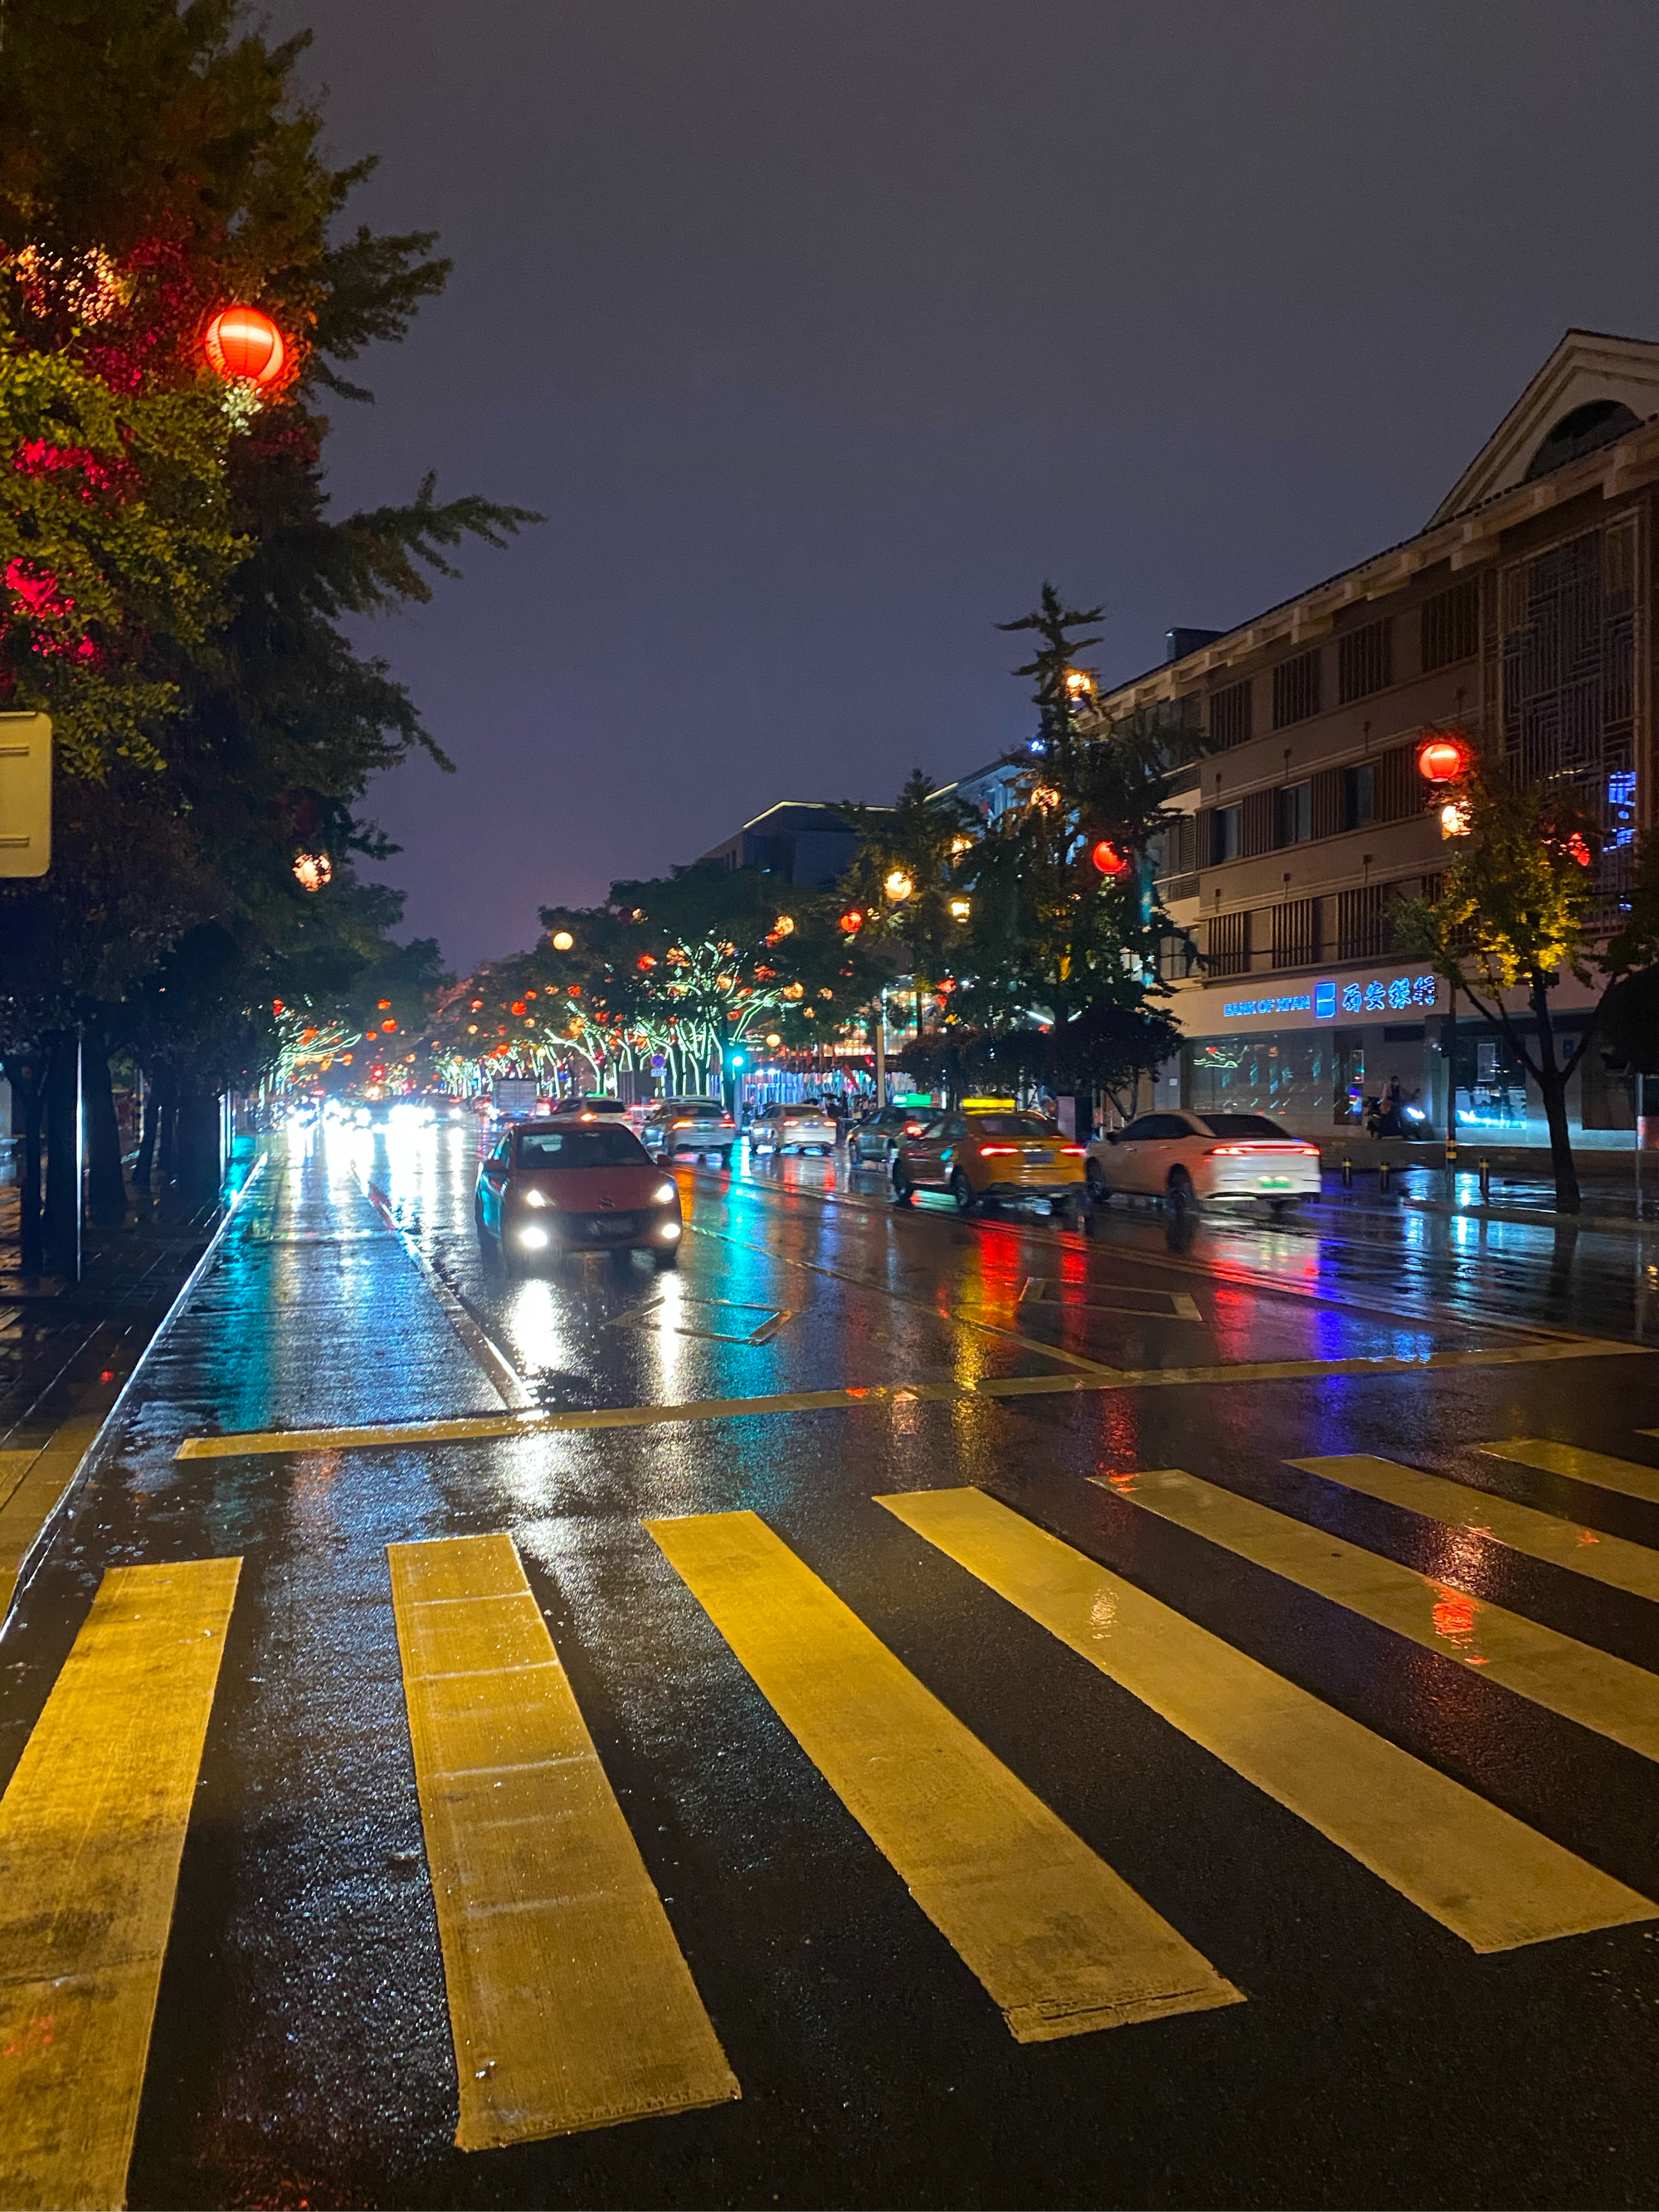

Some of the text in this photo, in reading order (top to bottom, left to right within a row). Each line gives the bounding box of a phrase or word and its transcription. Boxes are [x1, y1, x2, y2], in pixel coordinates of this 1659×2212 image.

[1224, 995, 1311, 1017] BANK OF XI'AN
